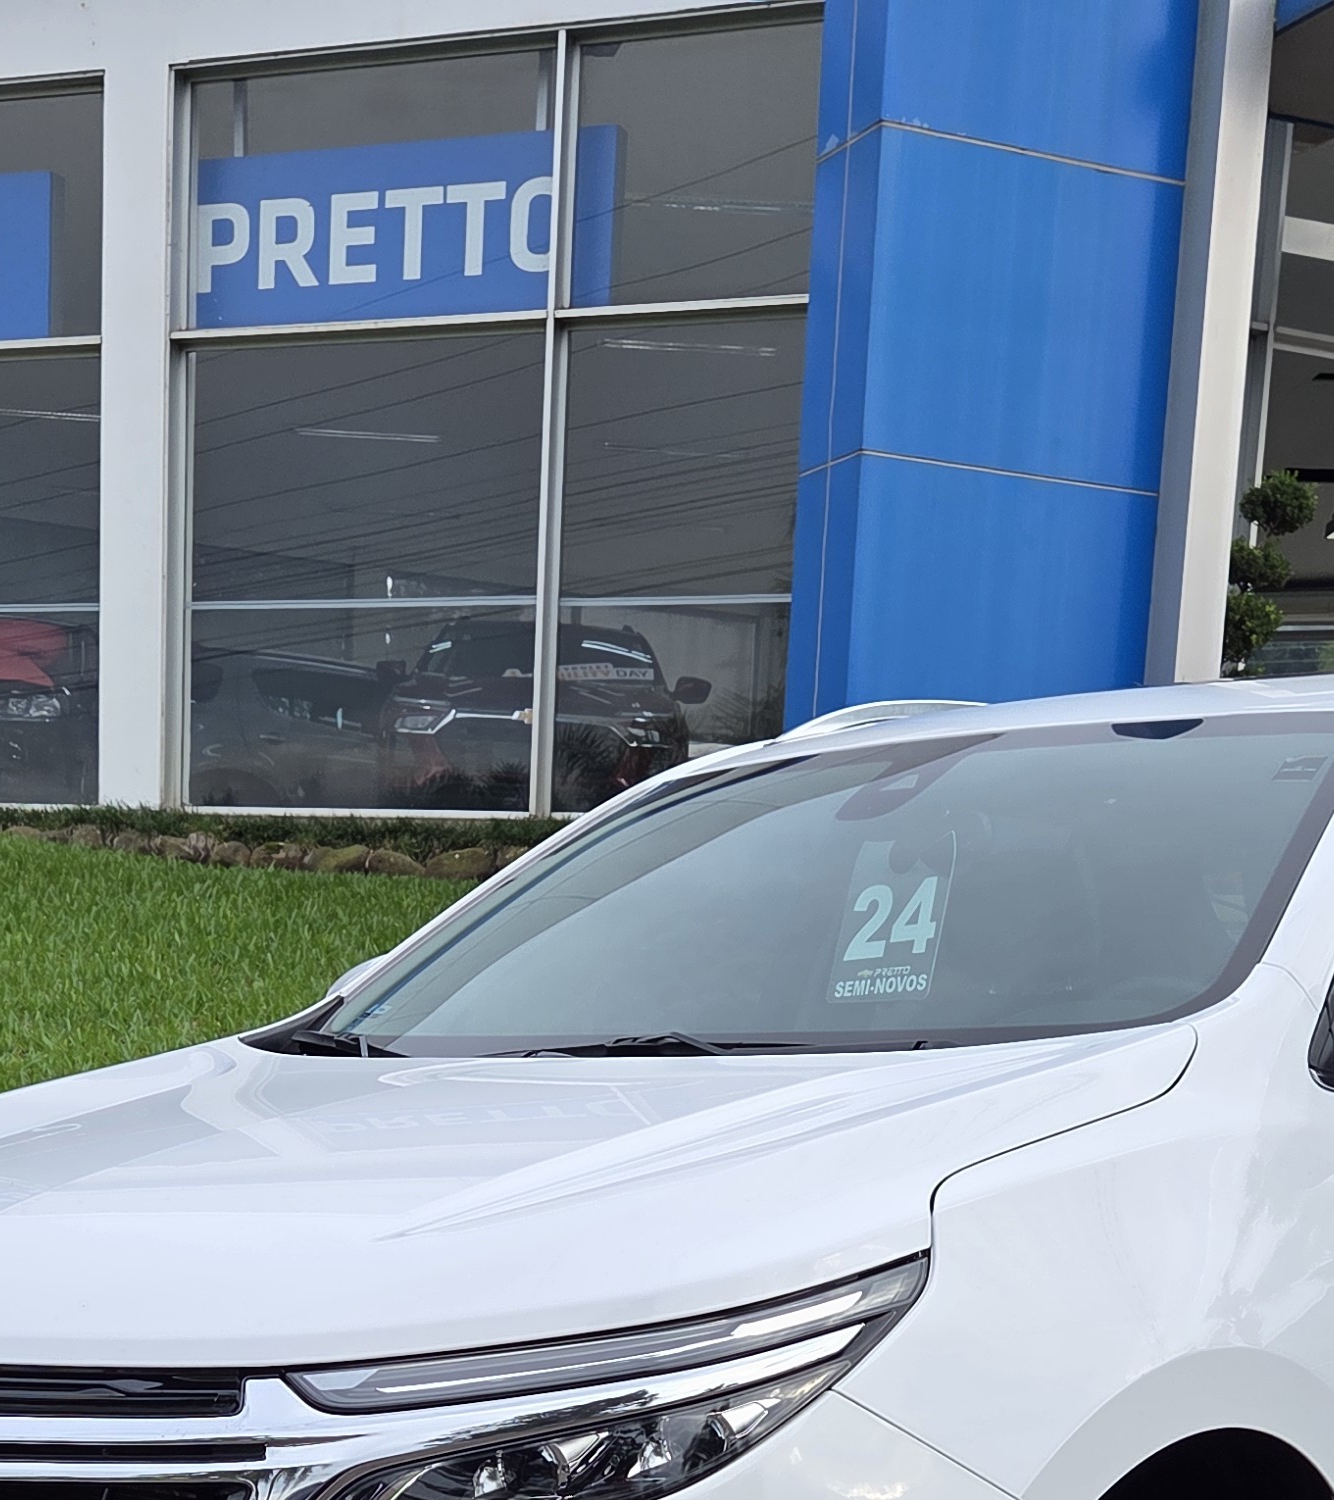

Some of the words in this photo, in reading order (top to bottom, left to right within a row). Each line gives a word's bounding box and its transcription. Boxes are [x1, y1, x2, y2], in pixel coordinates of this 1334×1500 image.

[843, 875, 939, 962] 24
[873, 965, 911, 978] PRETTO
[833, 973, 928, 998] SEMI-NOVOS
